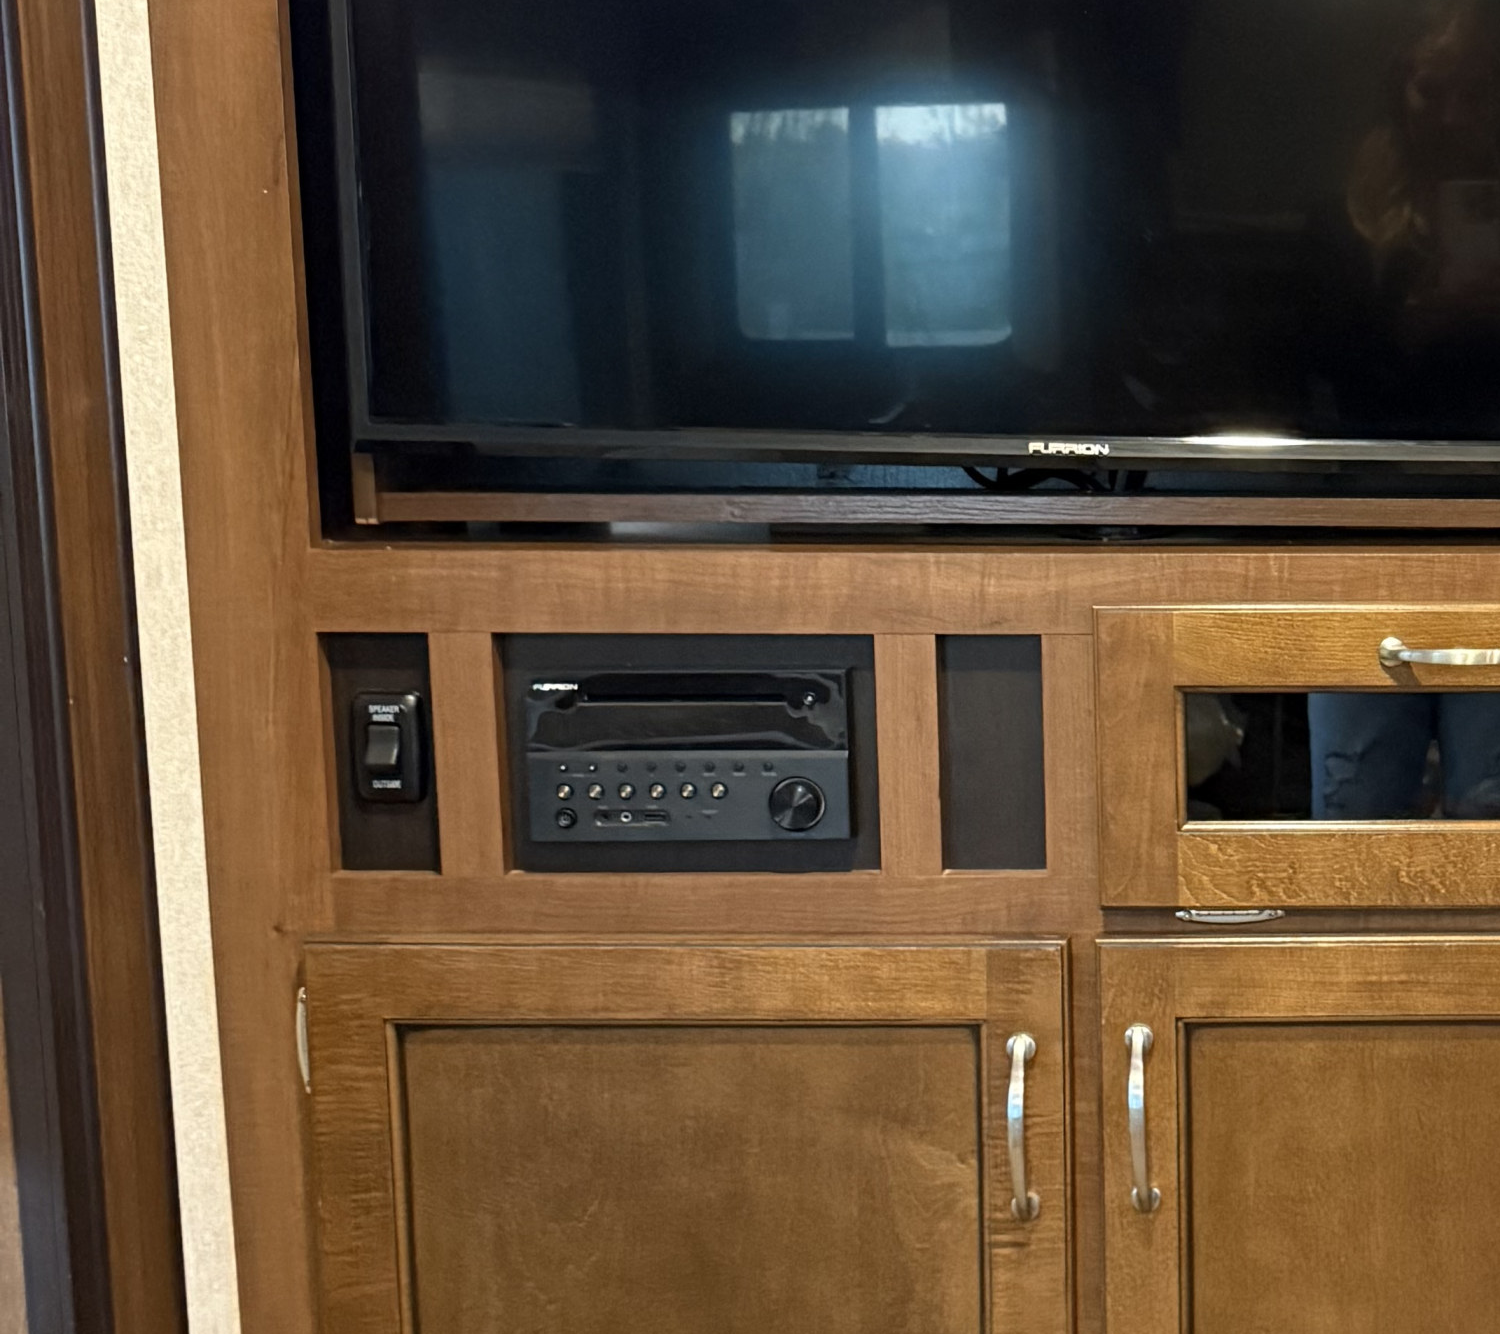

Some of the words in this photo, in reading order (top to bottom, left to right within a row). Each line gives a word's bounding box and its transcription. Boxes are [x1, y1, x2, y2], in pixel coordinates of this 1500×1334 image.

[1028, 442, 1110, 456] FURRION
[368, 704, 400, 714] SPEAKER
[372, 779, 402, 789] OUTSIDE
